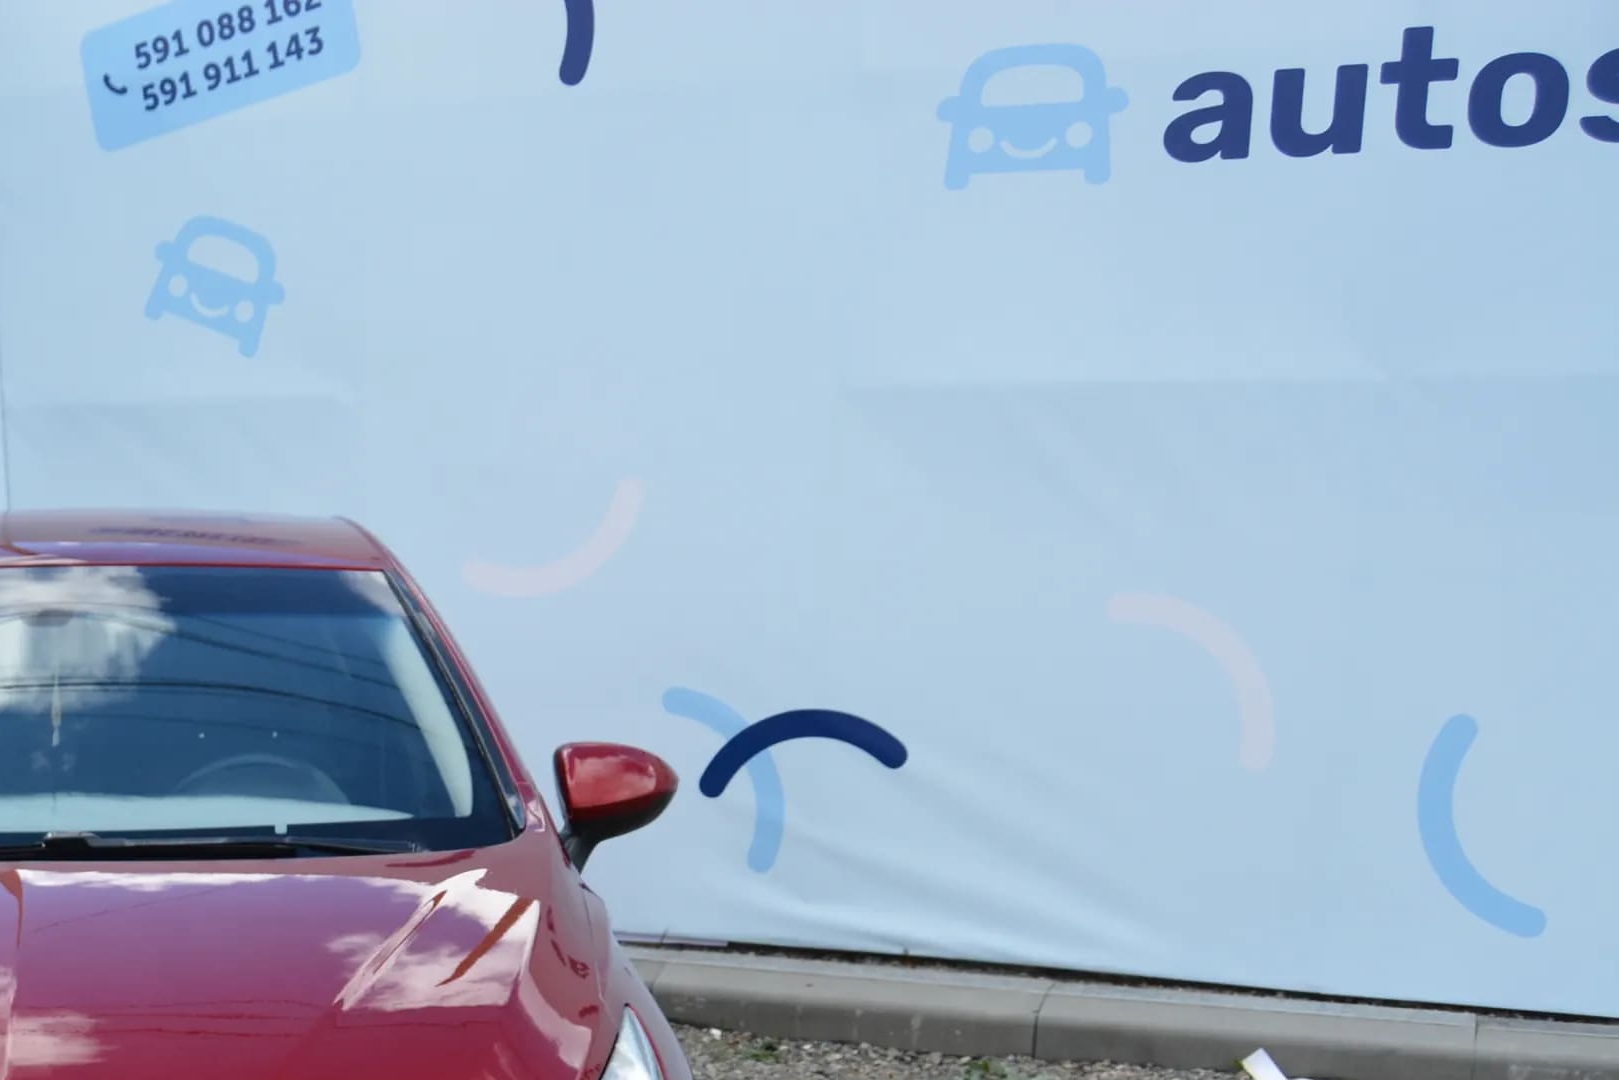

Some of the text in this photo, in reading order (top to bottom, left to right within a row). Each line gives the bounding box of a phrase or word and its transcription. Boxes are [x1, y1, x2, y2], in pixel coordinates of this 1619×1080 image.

[135, 29, 190, 70] 591
[196, 5, 256, 48] 088
[142, 26, 324, 112] 591 911 143
